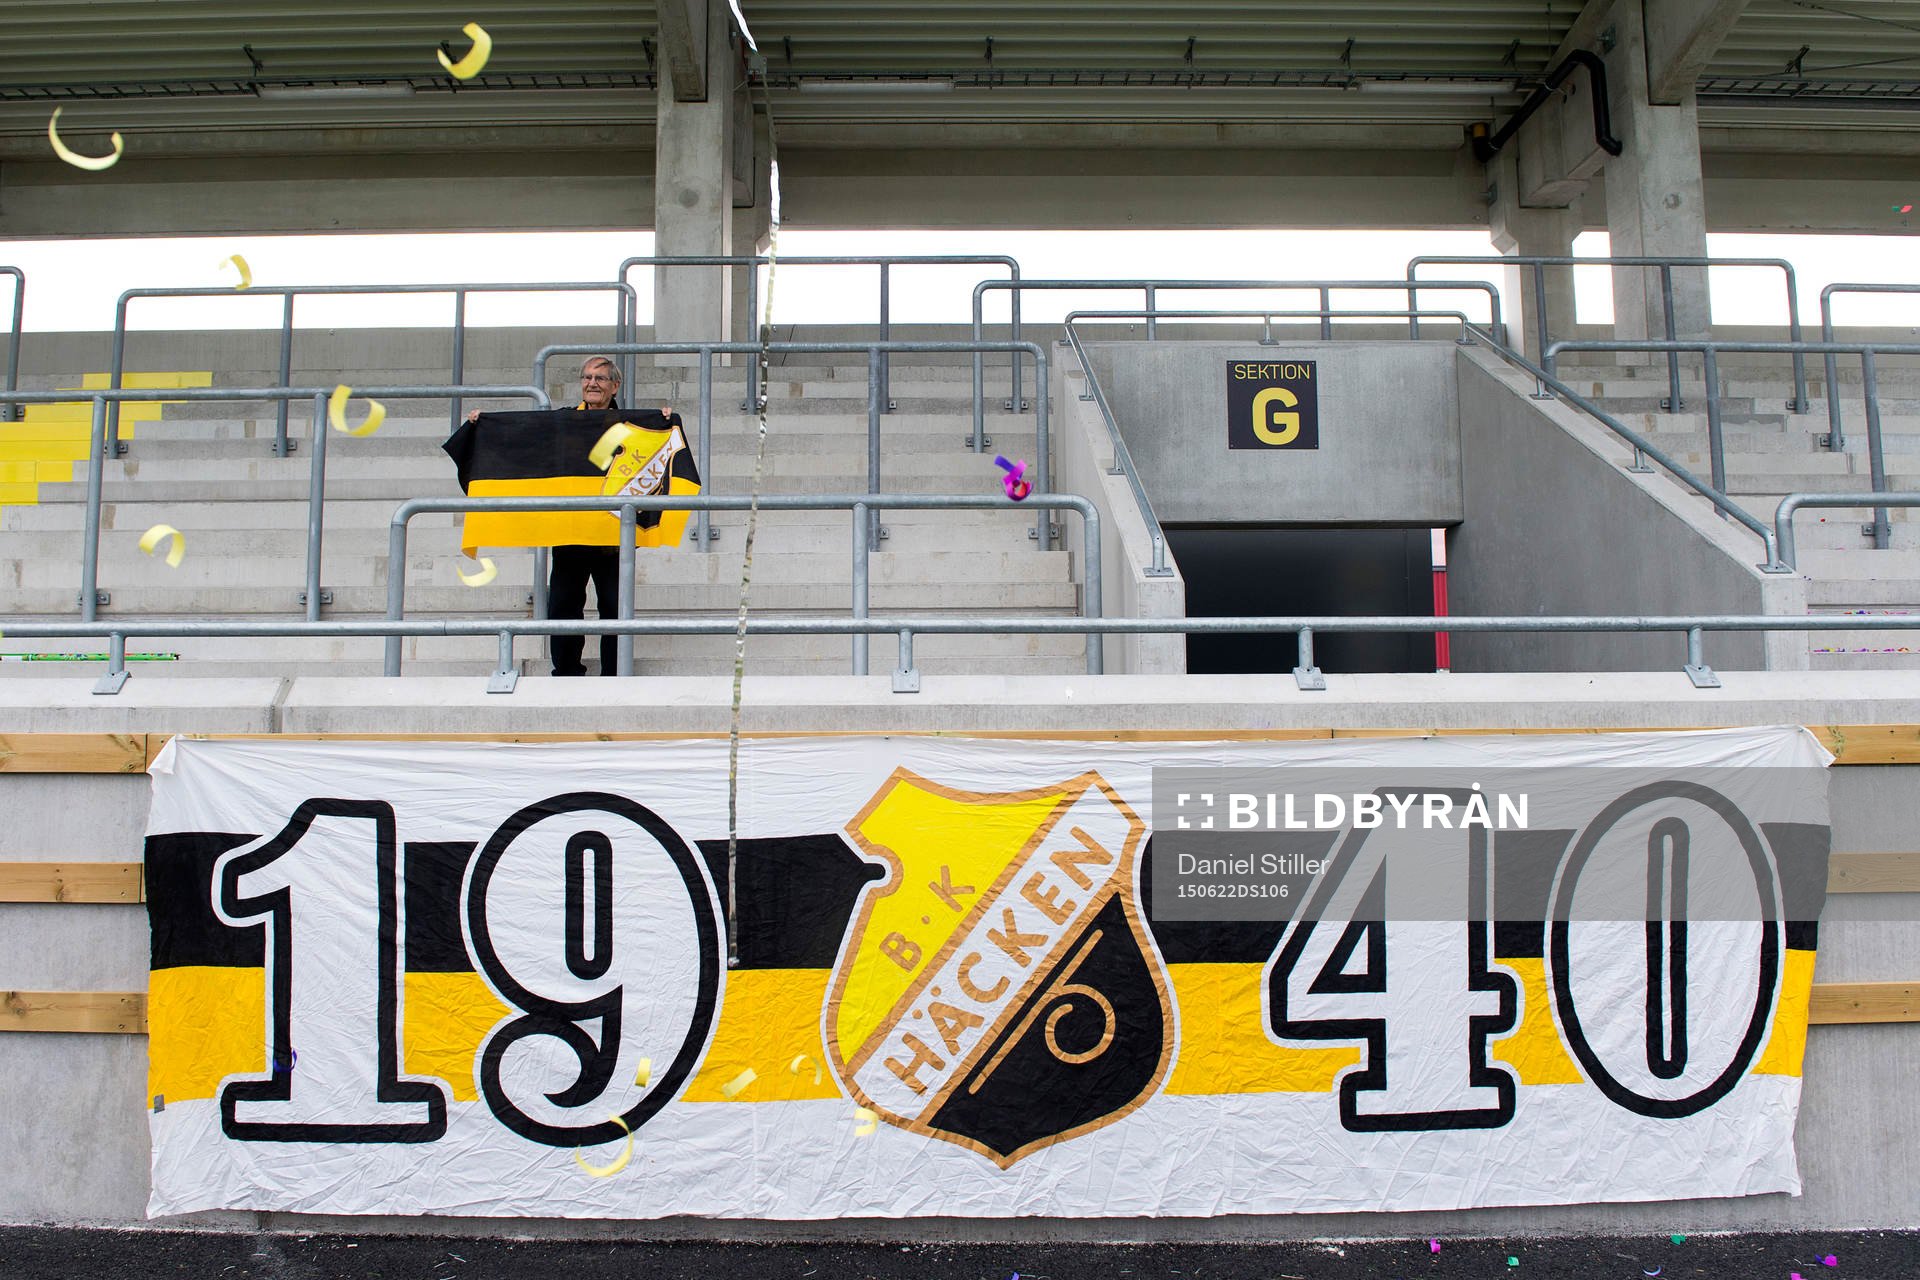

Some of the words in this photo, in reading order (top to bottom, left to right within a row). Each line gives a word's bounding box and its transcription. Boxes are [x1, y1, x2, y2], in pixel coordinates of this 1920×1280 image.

[1234, 364, 1310, 380] SEKTION
[1252, 387, 1300, 446] G
[220, 791, 720, 1147] 19
[1269, 780, 1779, 1132] 40
[883, 826, 1114, 1097] HÄCKEN
